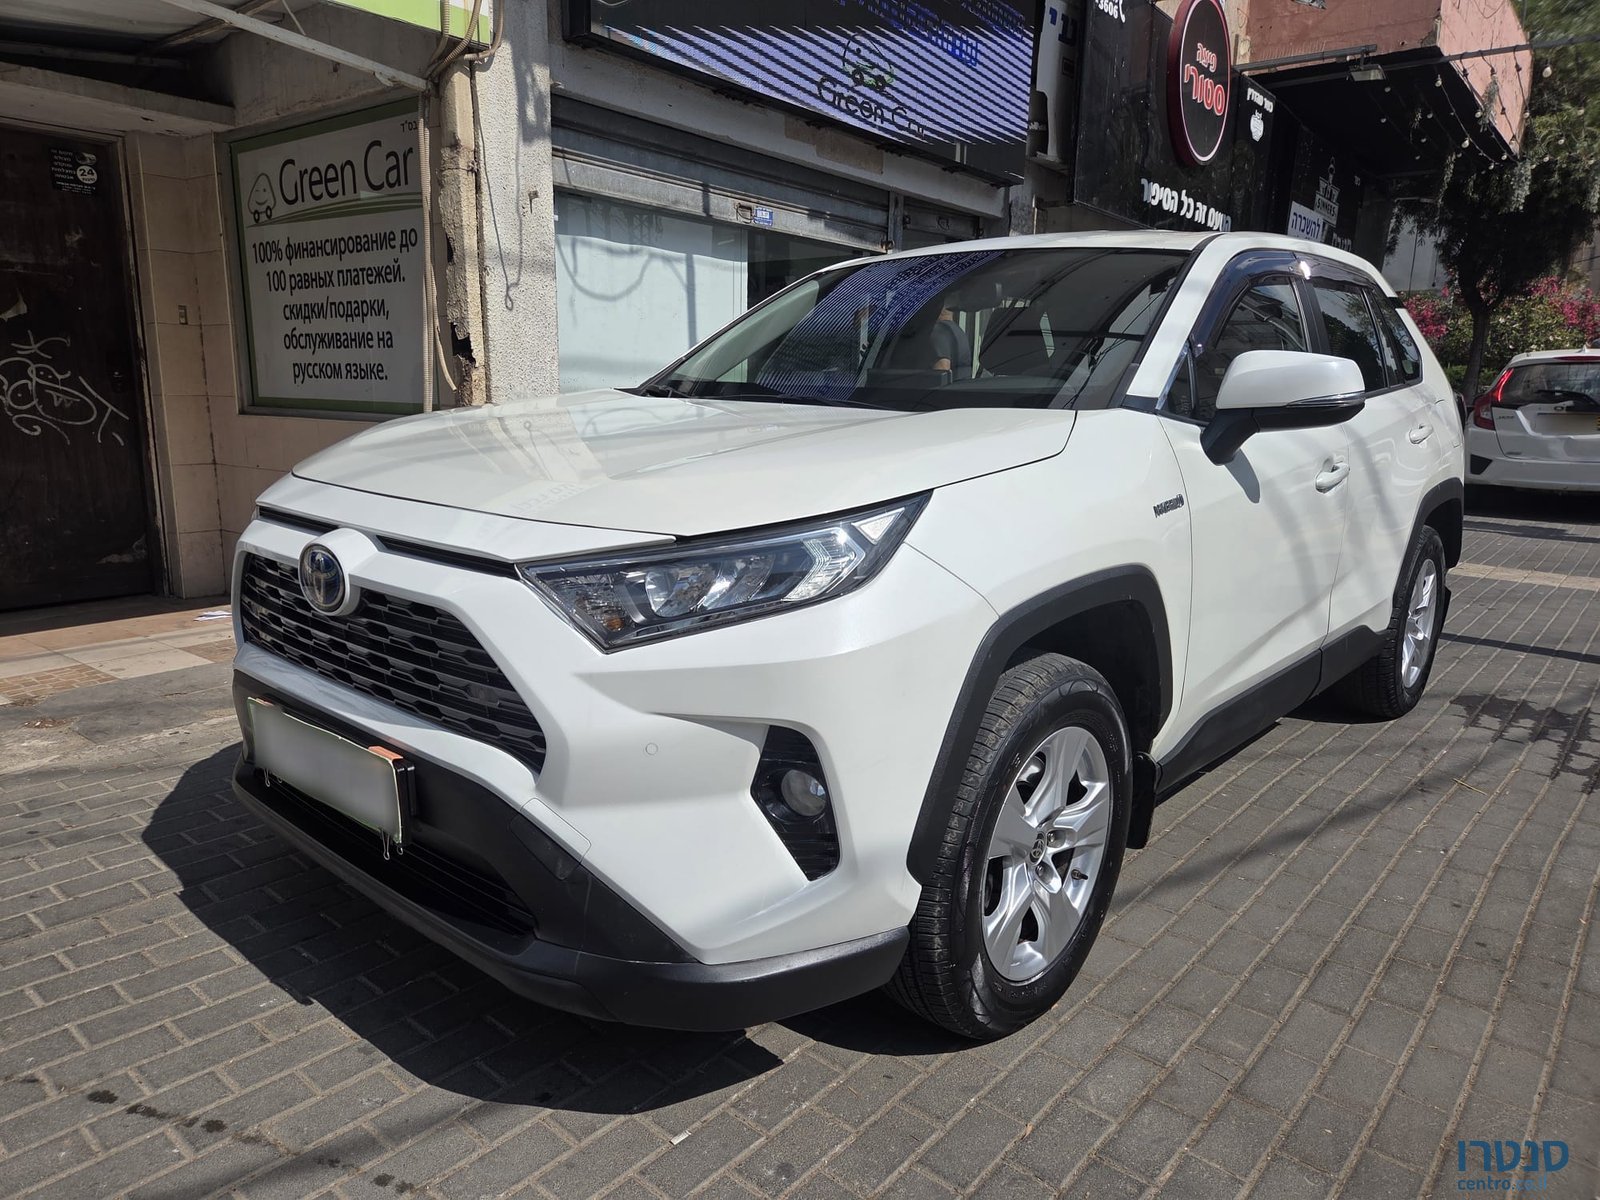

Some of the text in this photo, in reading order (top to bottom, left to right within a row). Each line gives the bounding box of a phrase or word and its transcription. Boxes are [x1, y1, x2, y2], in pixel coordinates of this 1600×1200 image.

[1197, 42, 1217, 72] פיצה
[817, 77, 884, 124] Green
[1184, 63, 1225, 116] סטורי
[79, 168, 95, 177] 24
[279, 140, 413, 205] Green Car
[1141, 178, 1179, 214] הסיפור
[1180, 189, 1194, 219] כל
[1194, 202, 1207, 225] זה
[1291, 211, 1321, 239] להשכרה
[252, 227, 418, 266] 100% финансирование до
[266, 258, 405, 296] 100 равных платежей.
[283, 296, 389, 324] скидки/подарки,
[284, 327, 393, 355] обслуживание на
[293, 361, 388, 384] русском языке.
